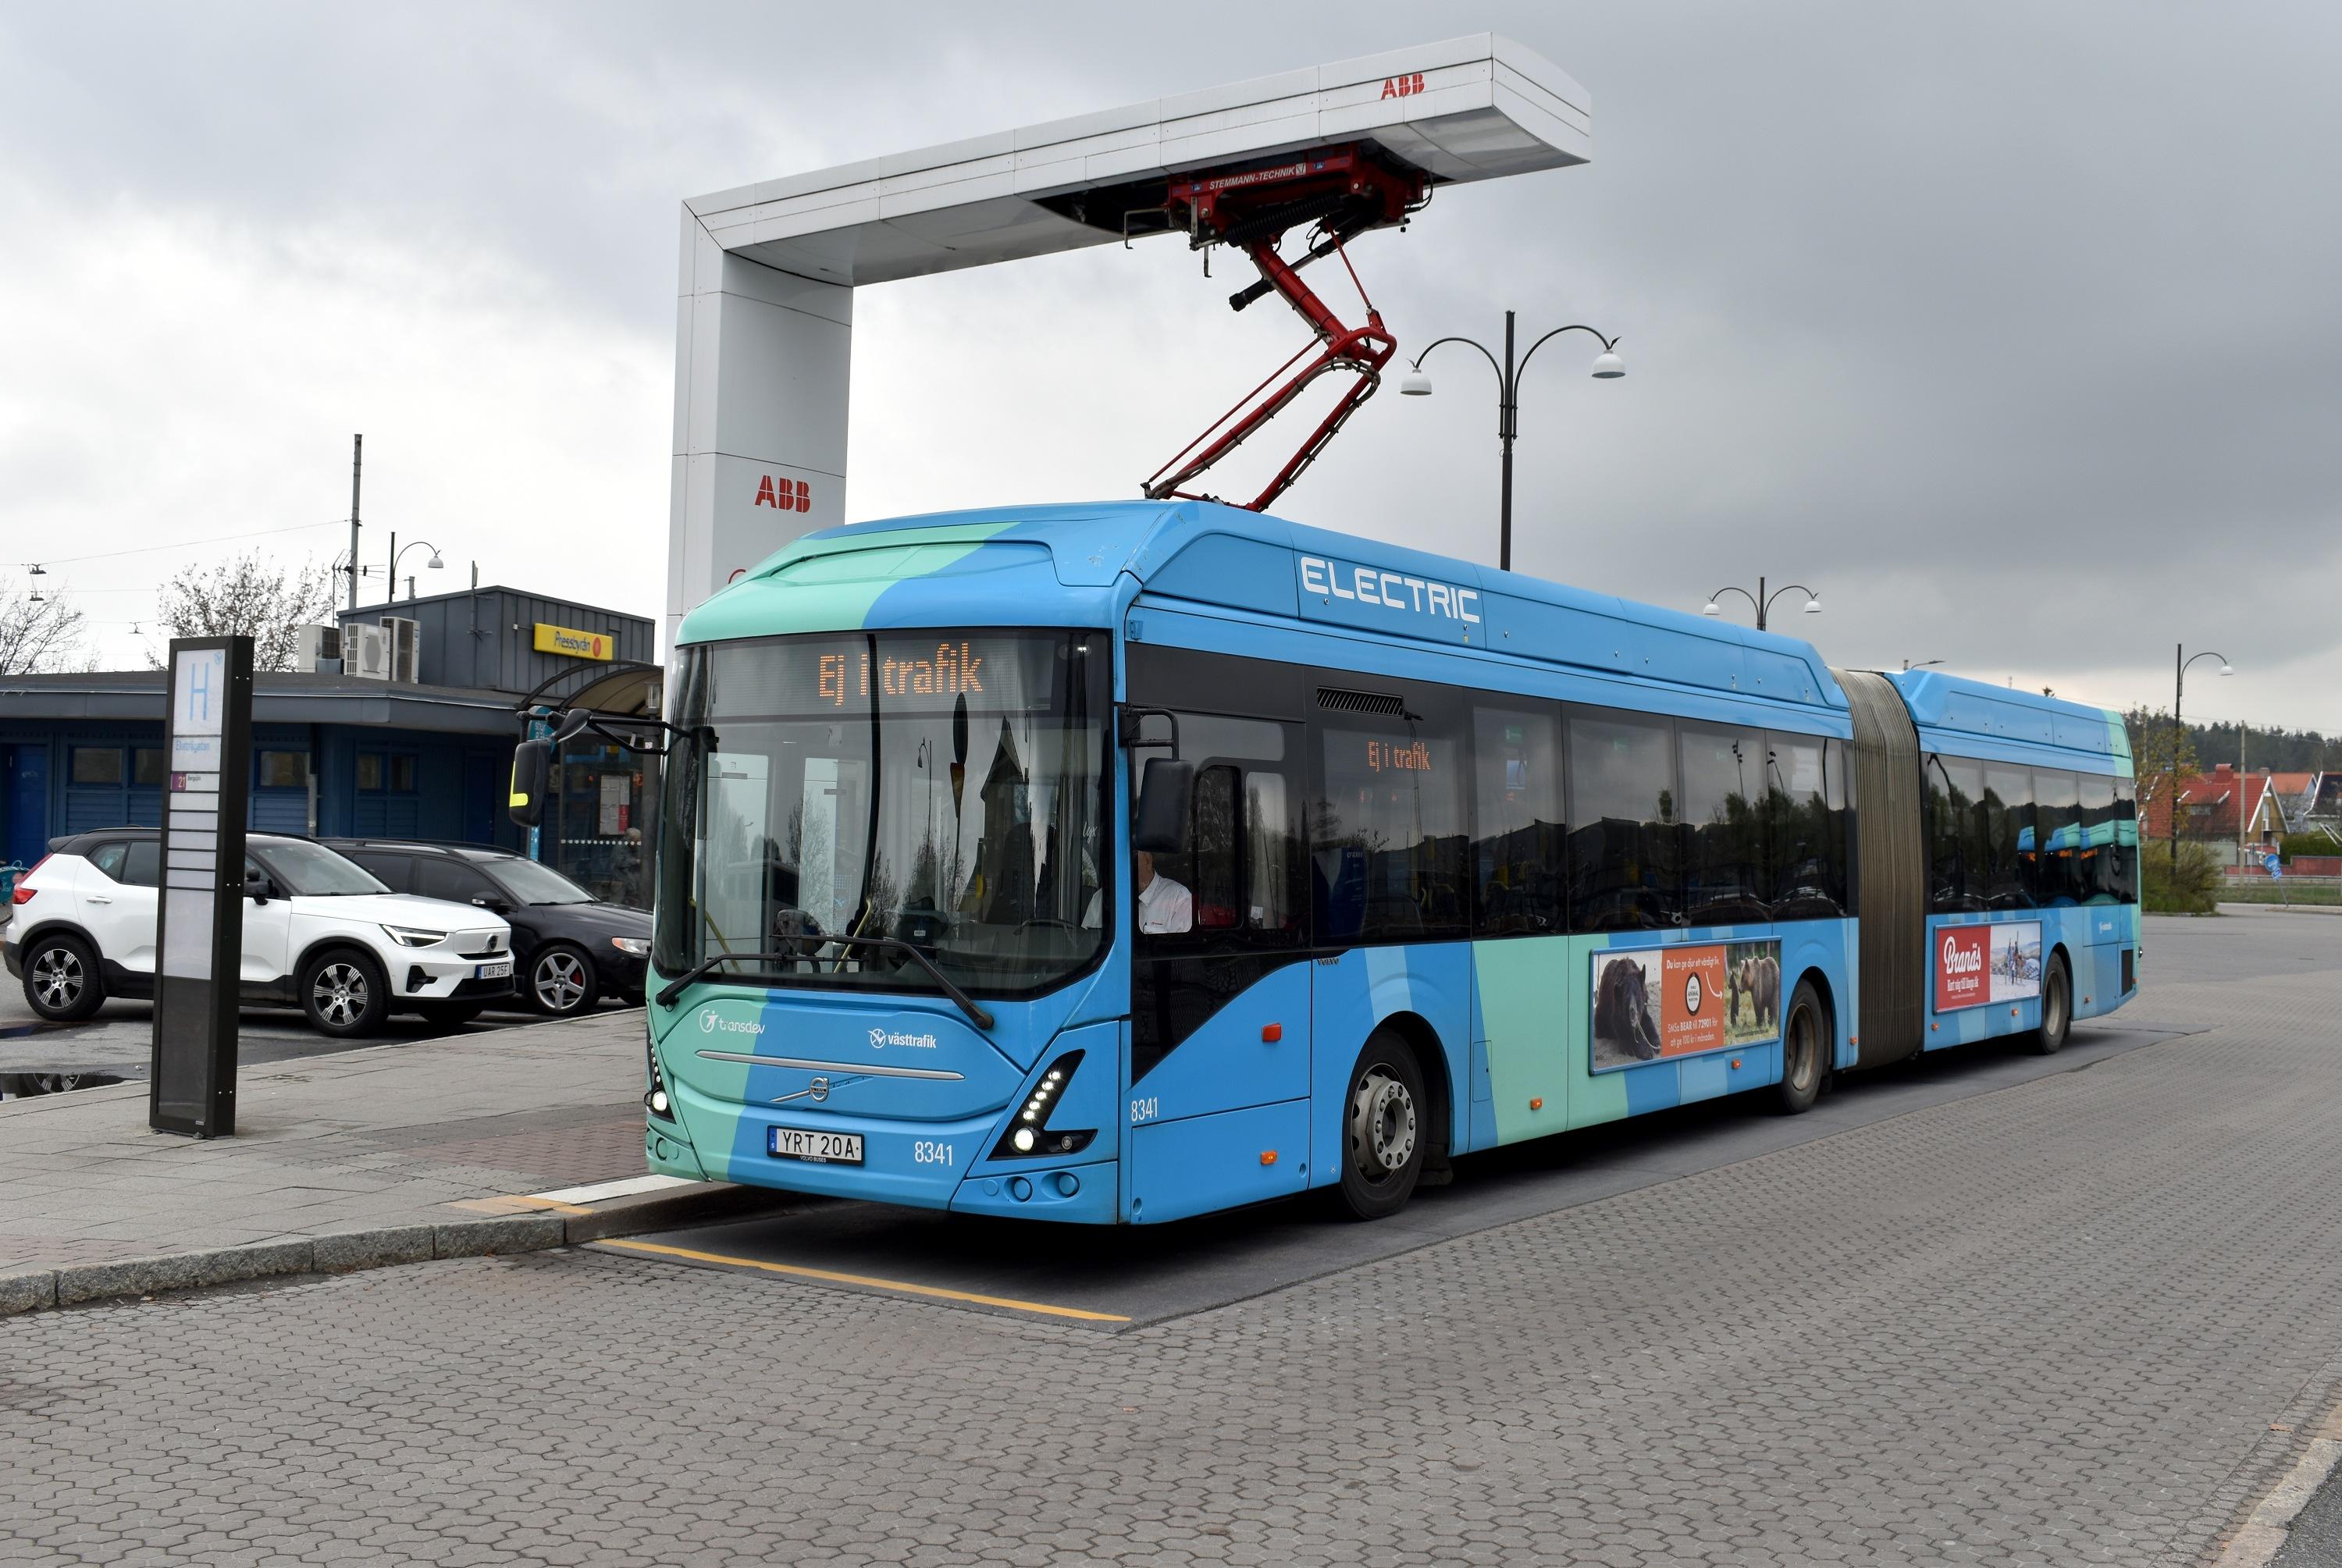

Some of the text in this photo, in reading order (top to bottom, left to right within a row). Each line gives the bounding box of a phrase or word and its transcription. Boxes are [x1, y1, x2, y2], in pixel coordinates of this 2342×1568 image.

[1380, 73, 1425, 100] ABB
[1209, 166, 1296, 190] STEMMANN-TECHNIK
[754, 475, 811, 513] ABB
[1301, 556, 1480, 624] ELECTRIC
[554, 631, 591, 654] Pressbyrån
[820, 642, 984, 706] Ej i trafik
[190, 663, 209, 721] H
[1368, 741, 1431, 772] Ej i trafik
[178, 776, 186, 788] 21
[1666, 959, 1674, 969] Du
[1944, 936, 1981, 974] Branäs
[1679, 1021, 1692, 1032] BEAR
[1698, 1018, 1711, 1029] 72901
[888, 1032, 937, 1048] västtrafik
[1131, 1097, 1158, 1122] 8341
[782, 1131, 855, 1158] YRT 20A
[914, 1141, 952, 1167] 8341
